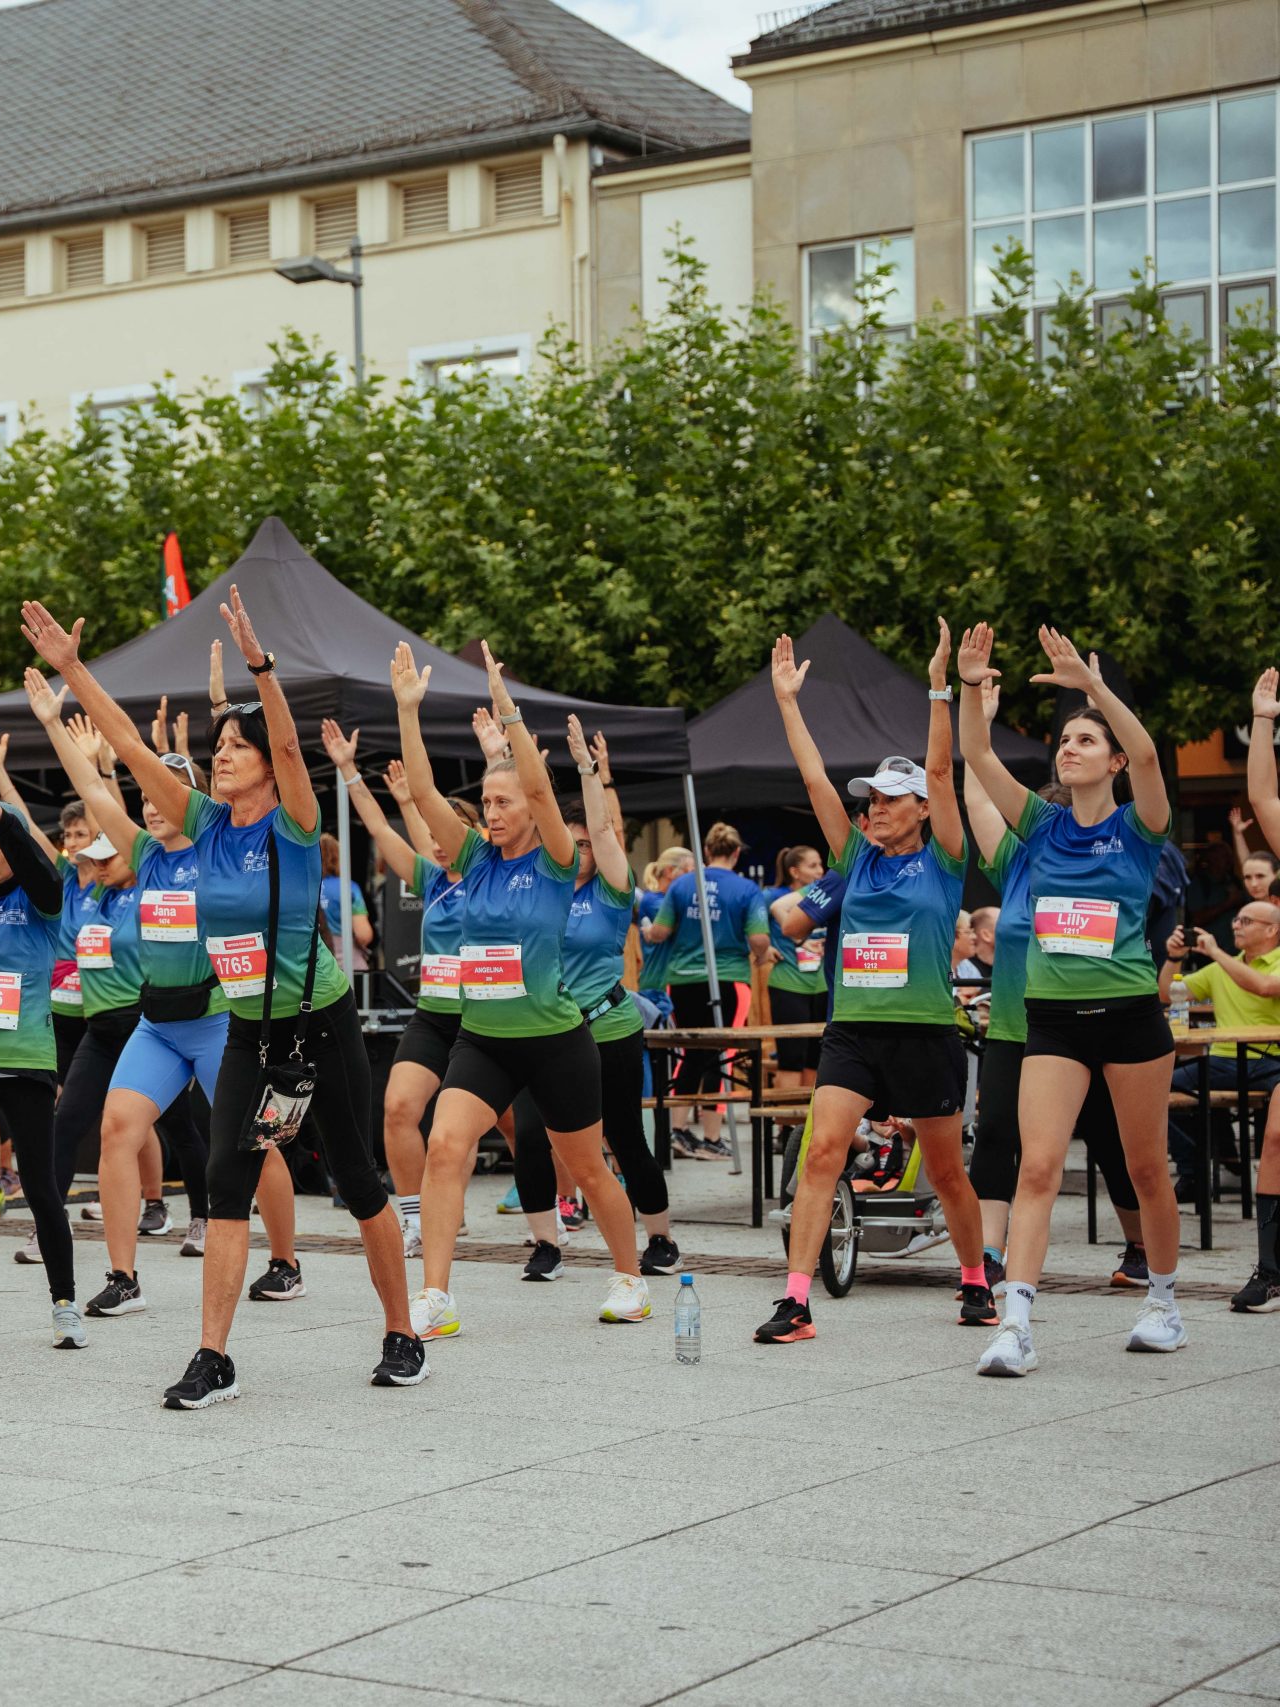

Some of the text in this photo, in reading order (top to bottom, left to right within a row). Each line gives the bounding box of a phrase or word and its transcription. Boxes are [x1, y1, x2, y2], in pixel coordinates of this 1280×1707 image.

[153, 905, 177, 917] Jana
[1057, 912, 1090, 930] Lilly
[855, 949, 888, 961] Petra
[217, 955, 253, 975] 1765
[474, 966, 504, 974] ANGELINA
[426, 966, 457, 977] Kerstin
